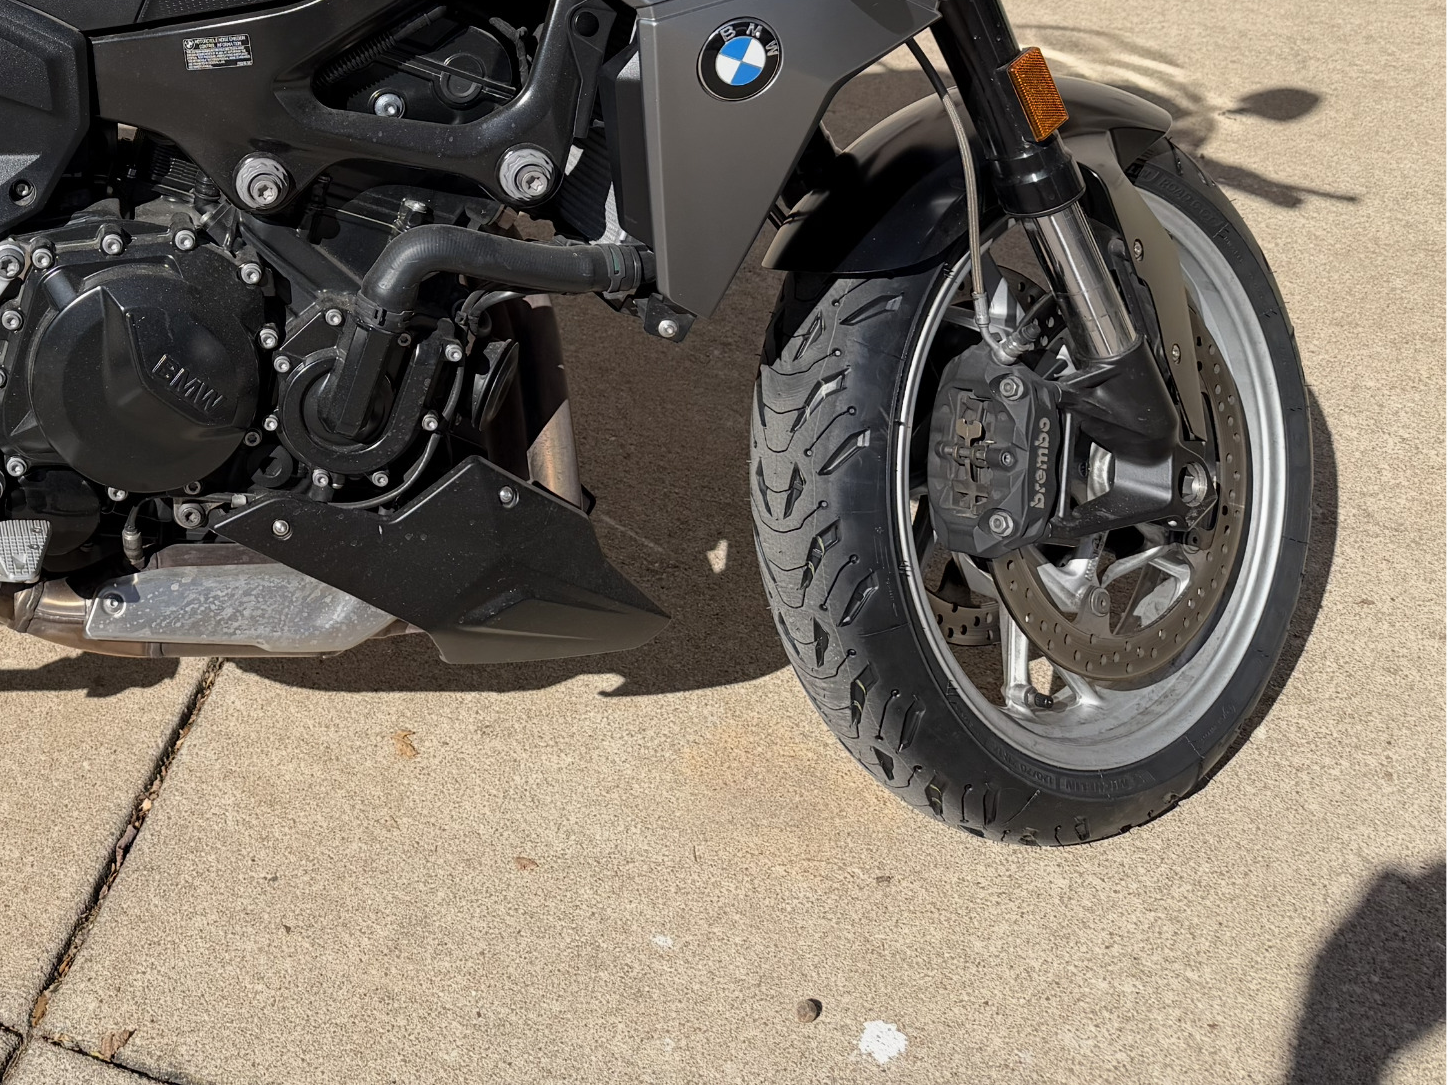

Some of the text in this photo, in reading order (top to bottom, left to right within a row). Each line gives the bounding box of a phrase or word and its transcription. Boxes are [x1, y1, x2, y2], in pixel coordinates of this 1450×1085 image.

[719, 22, 780, 57] BMW
[151, 353, 224, 411] BMW
[1030, 417, 1051, 509] brembo
